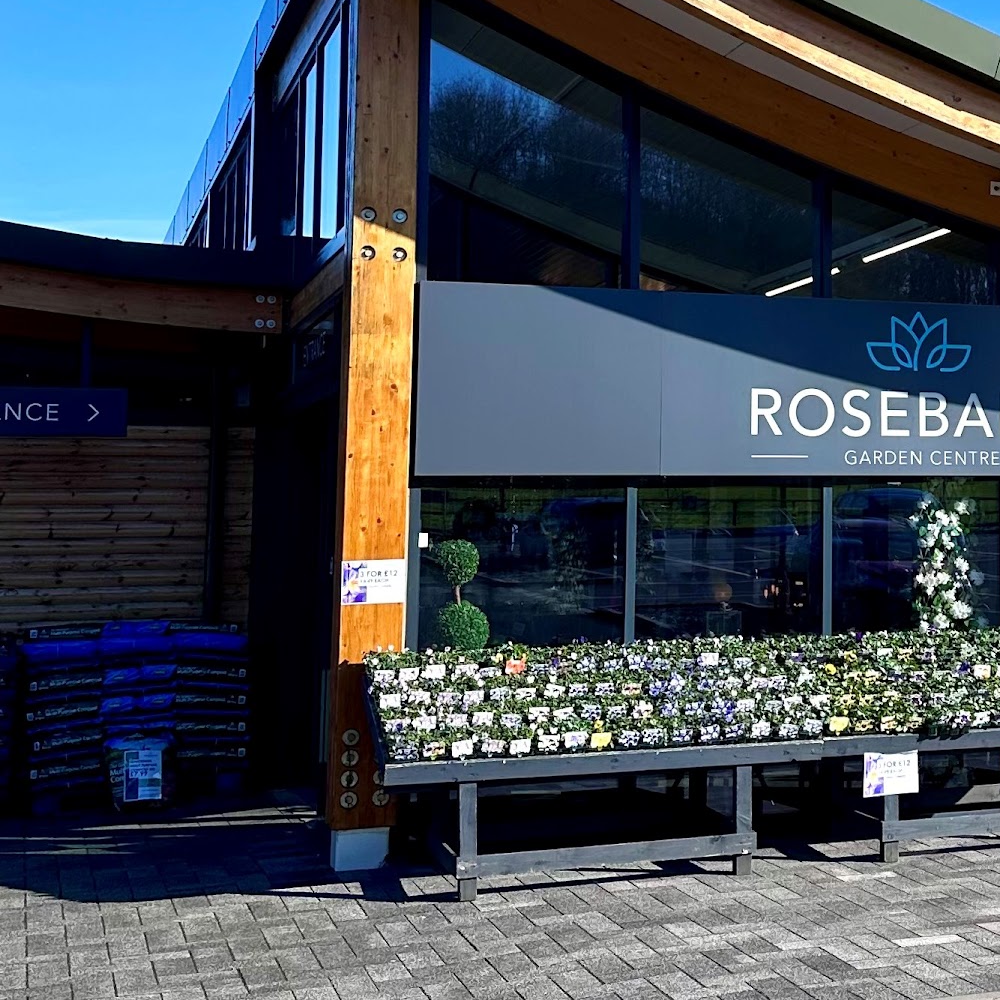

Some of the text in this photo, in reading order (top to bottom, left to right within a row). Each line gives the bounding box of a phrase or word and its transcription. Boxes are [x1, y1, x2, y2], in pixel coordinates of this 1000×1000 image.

[0, 402, 60, 421] NCE
[844, 450, 1000, 466] GARDEN CENTRE
